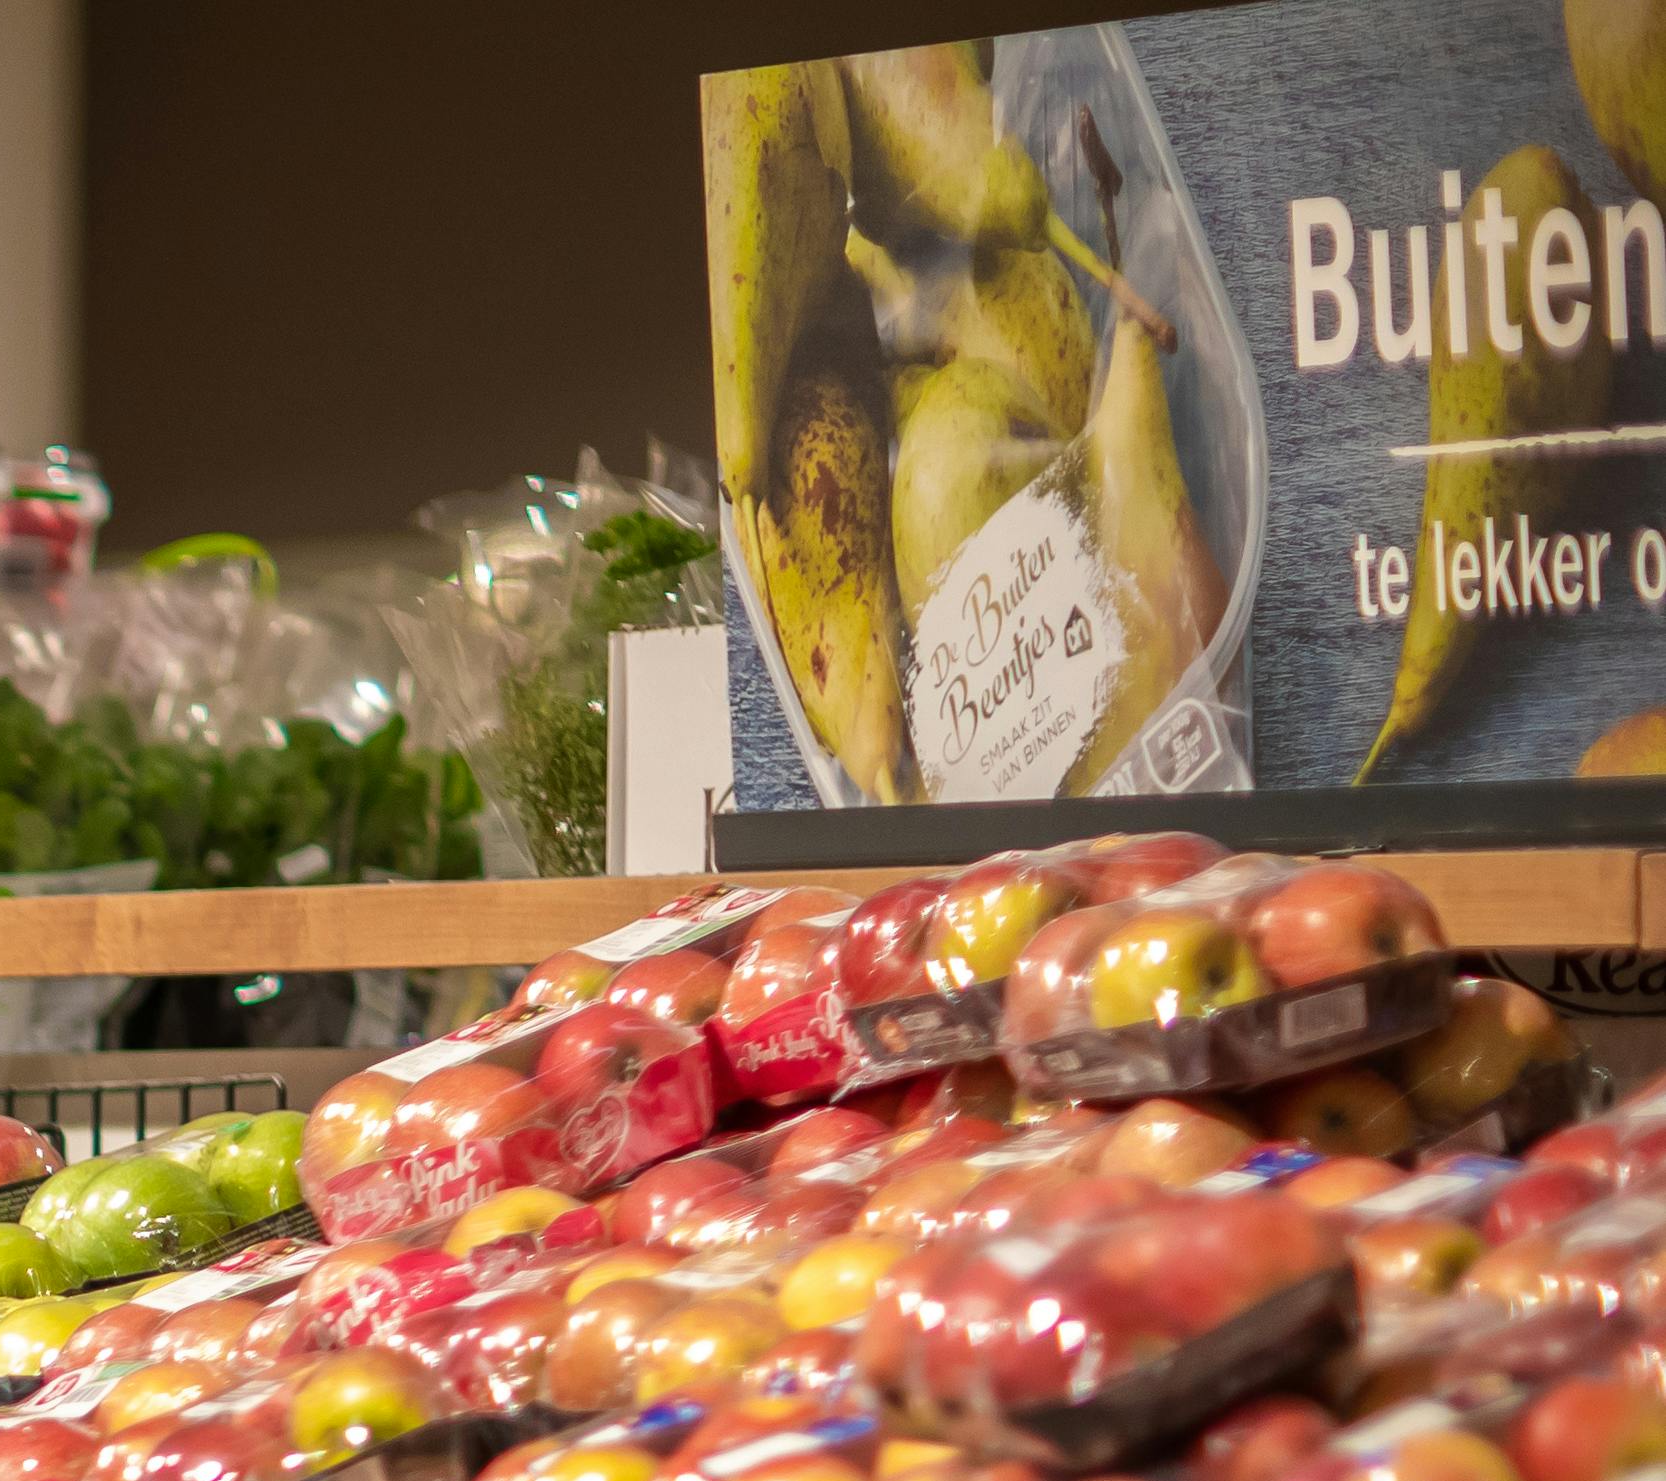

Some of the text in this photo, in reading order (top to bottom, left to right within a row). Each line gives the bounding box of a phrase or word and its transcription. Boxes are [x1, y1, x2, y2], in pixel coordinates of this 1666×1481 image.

[1290, 169, 1666, 368] Buiten
[930, 535, 1056, 689] De Buiten
[1354, 533, 1410, 618] te
[1432, 514, 1611, 613] lekker
[939, 615, 1055, 765] Beentjes
[980, 695, 1053, 775] SMAAK ZIT
[992, 707, 1077, 794] VAN BINNEN
